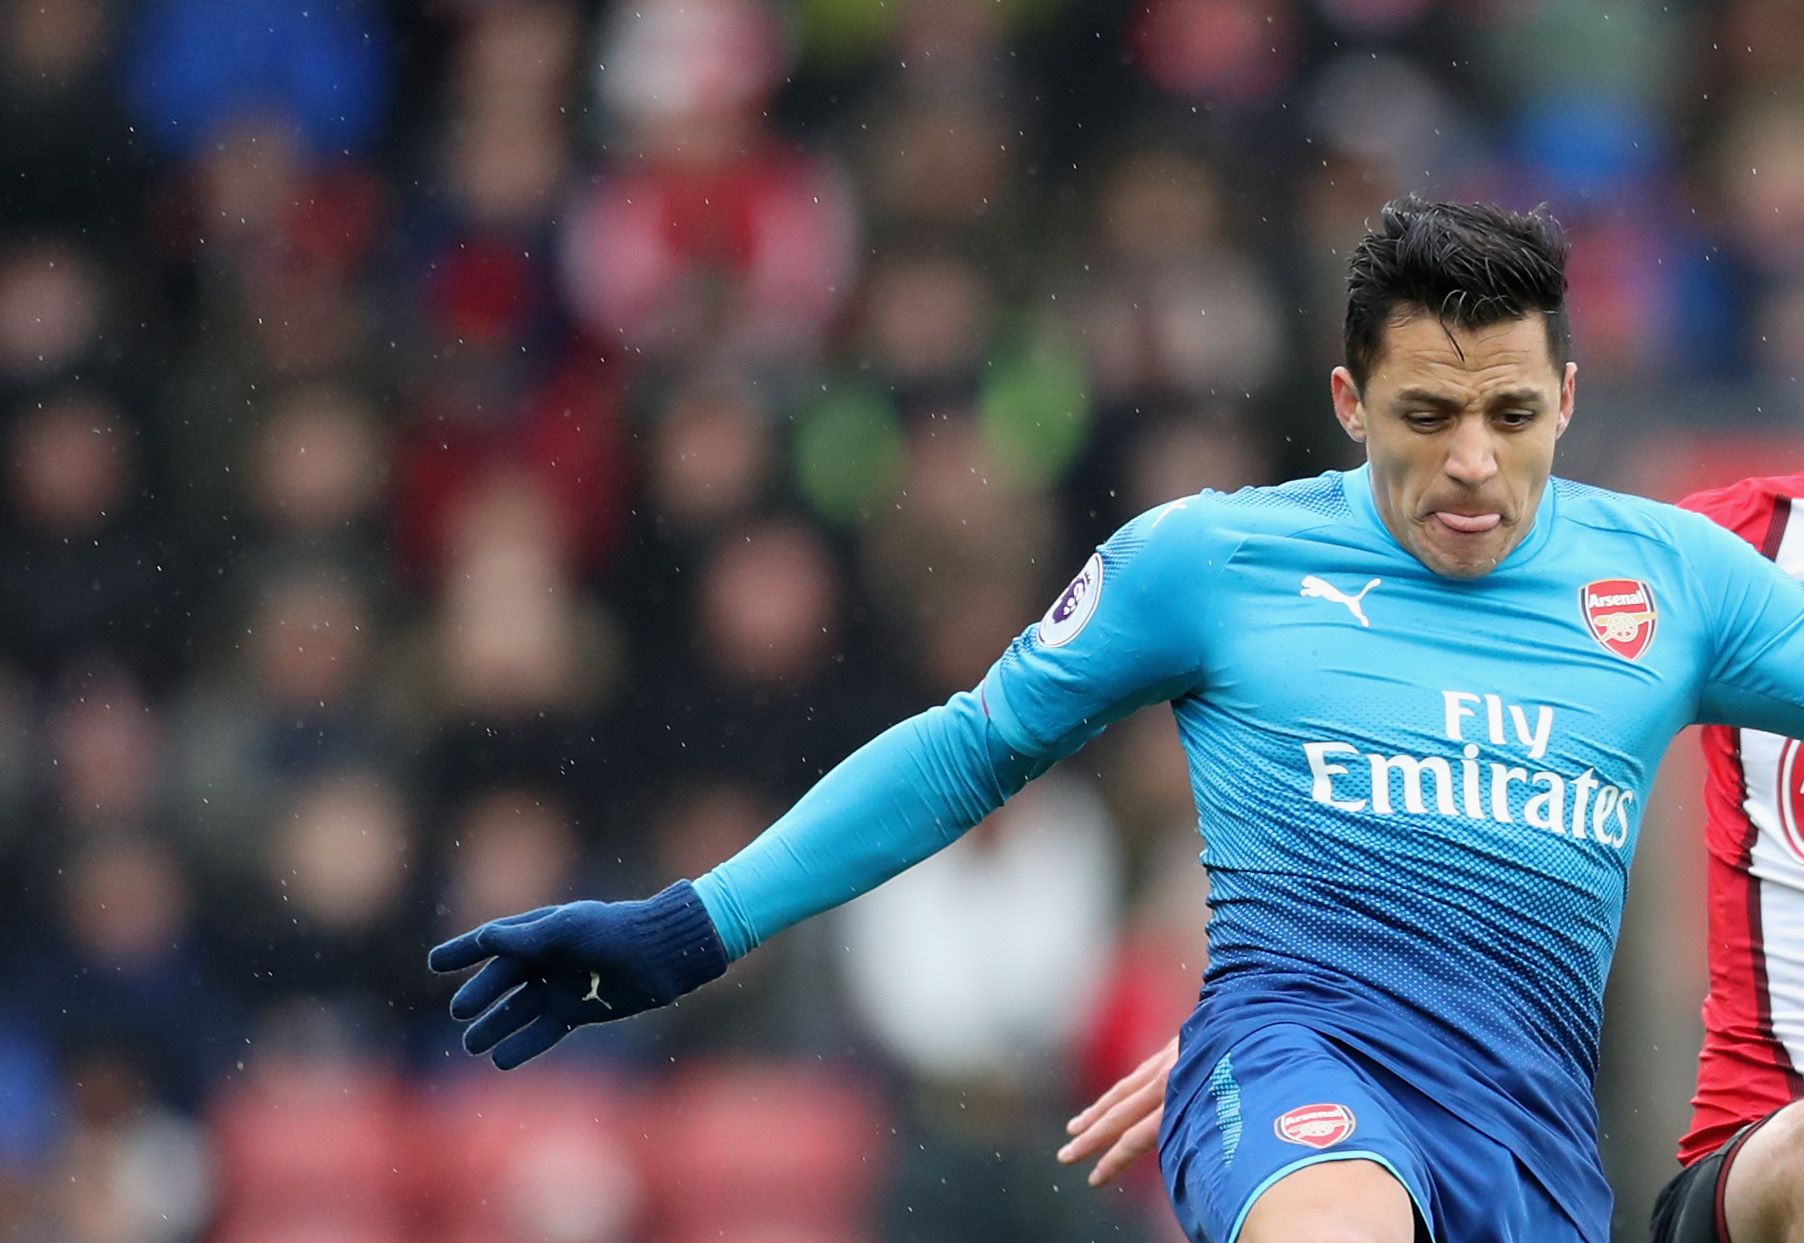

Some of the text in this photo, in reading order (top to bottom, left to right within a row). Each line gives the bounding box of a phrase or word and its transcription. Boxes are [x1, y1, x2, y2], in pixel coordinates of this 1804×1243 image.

[1589, 590, 1645, 609] Arsenal
[1442, 690, 1554, 759] Fly
[1303, 741, 1633, 849] Emirates
